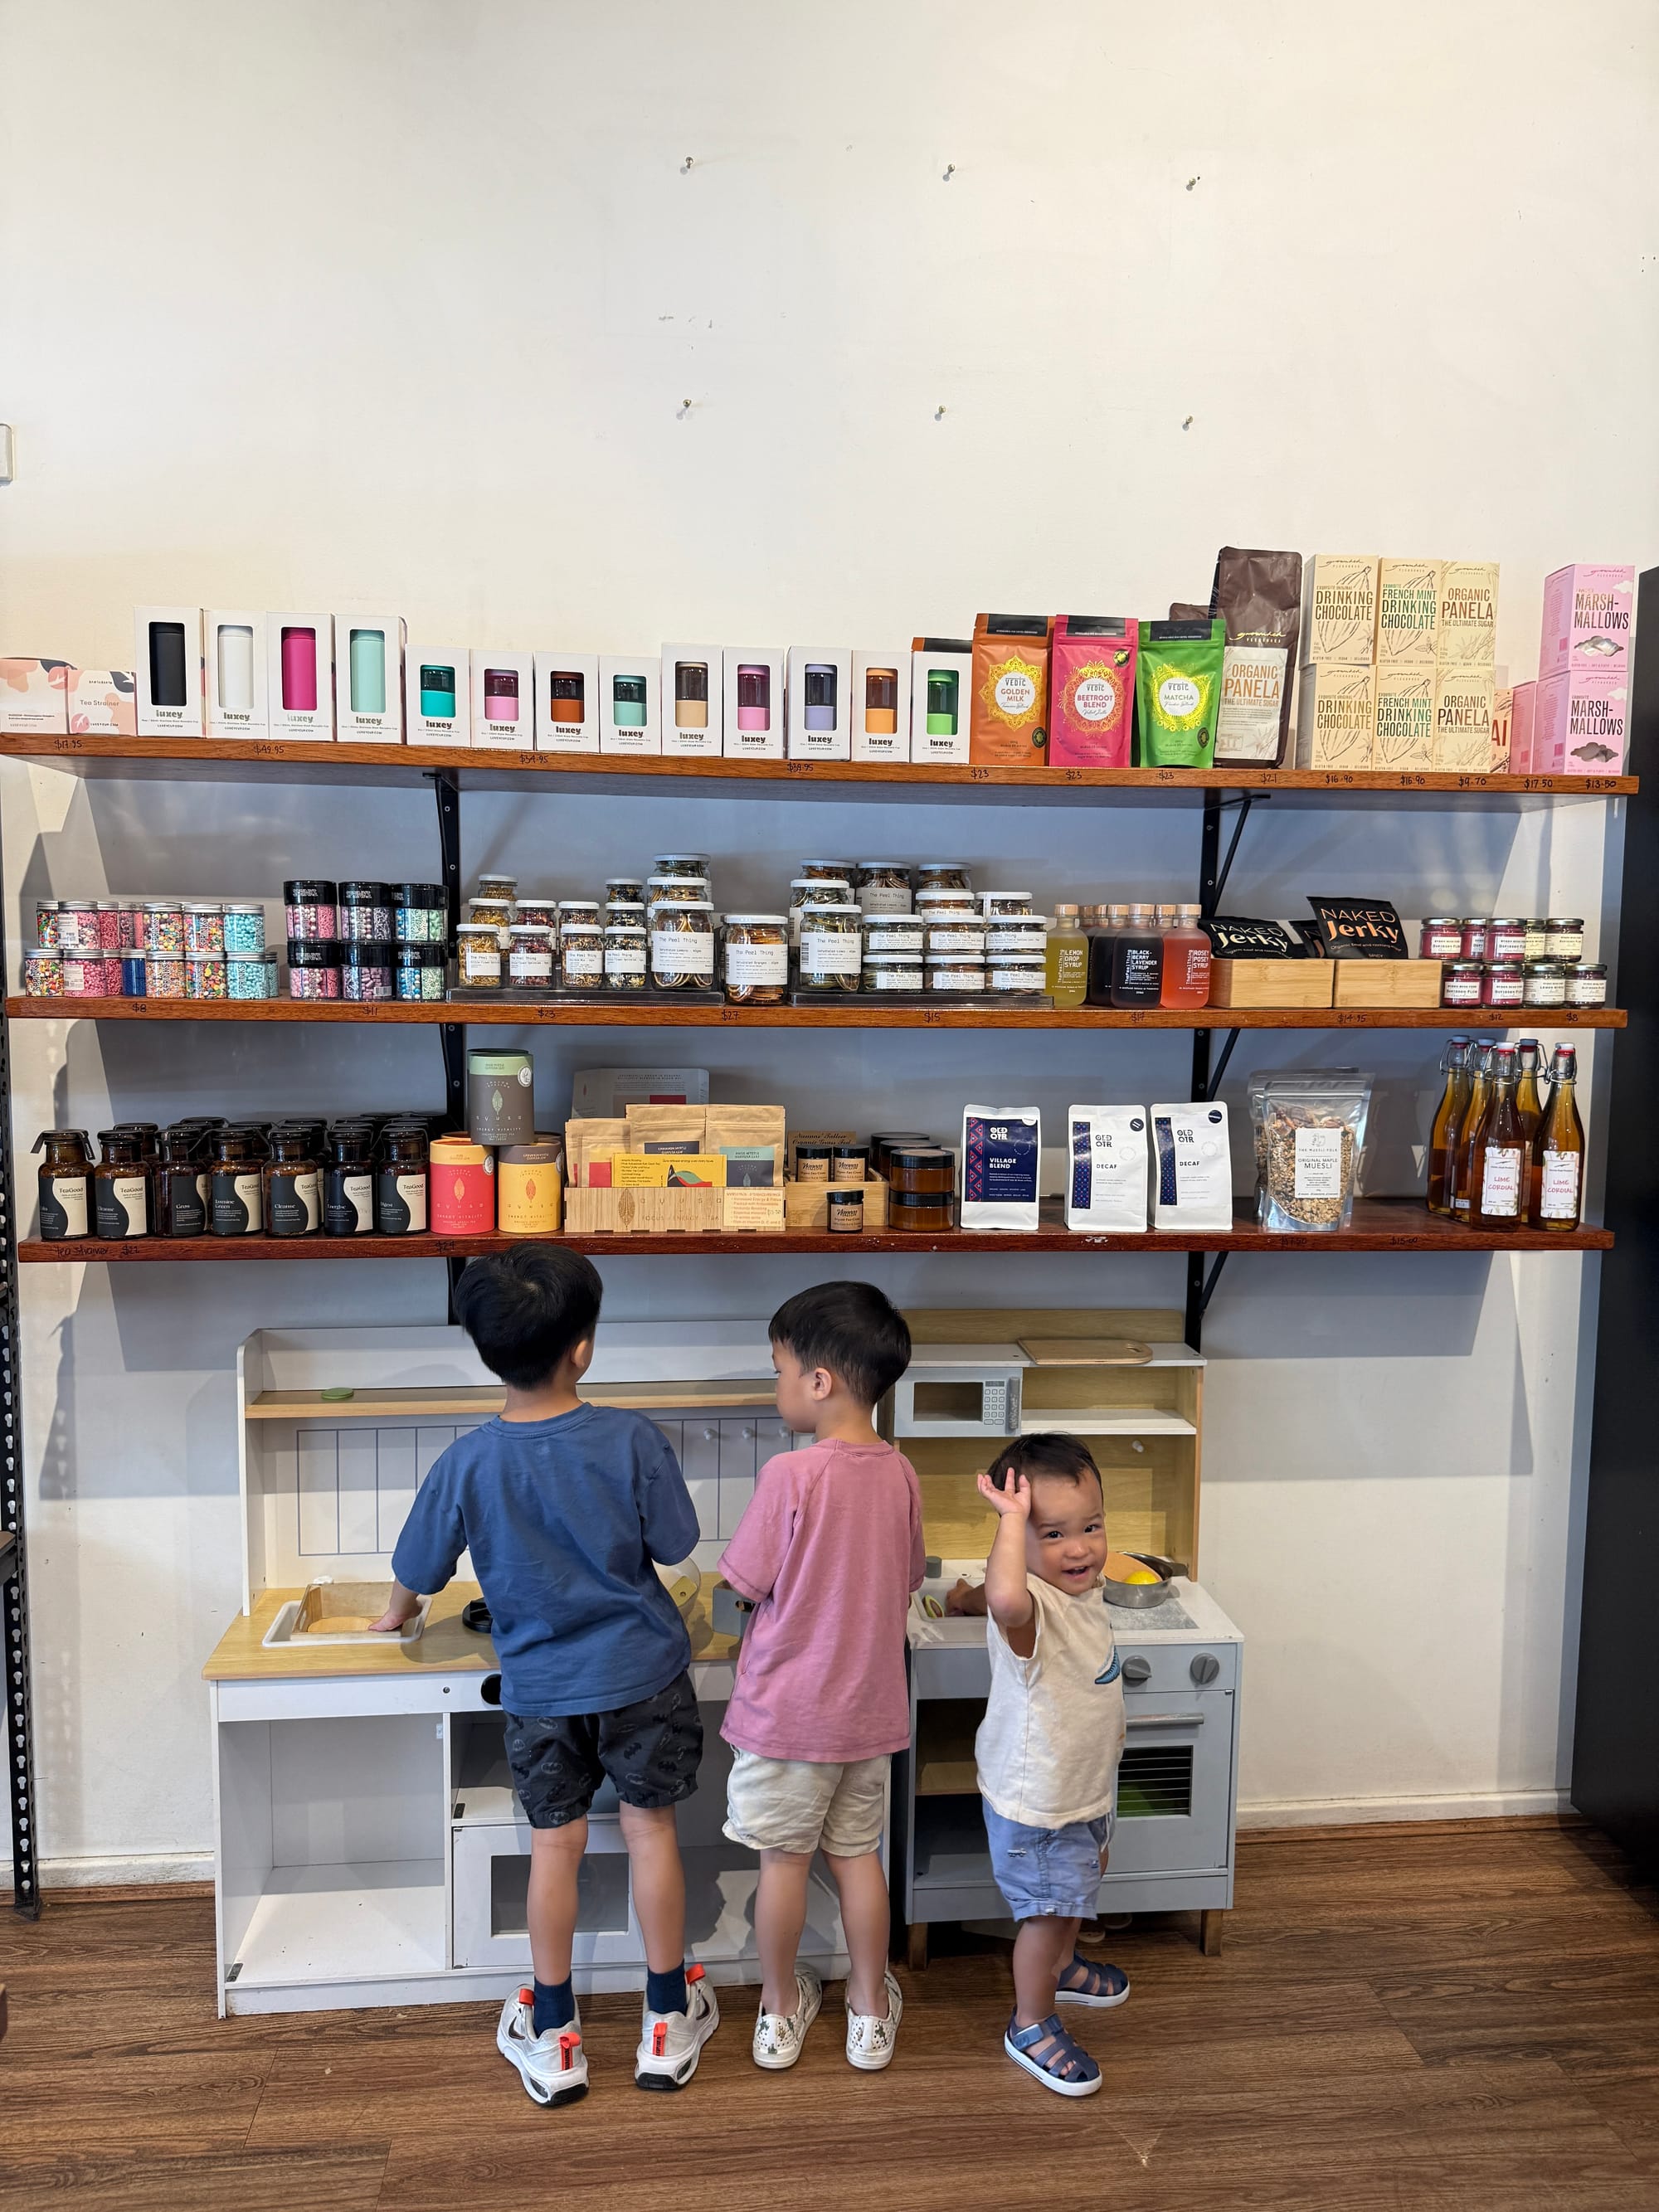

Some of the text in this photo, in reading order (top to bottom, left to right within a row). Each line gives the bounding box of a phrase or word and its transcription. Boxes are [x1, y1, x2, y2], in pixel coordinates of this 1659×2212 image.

[1316, 591, 1374, 605] DRINKING
[1382, 589, 1438, 600] FRENCH MINT
[1447, 587, 1491, 601] ORGANIC
[1382, 600, 1437, 614] DRINKING
[1575, 593, 1619, 610] MARSH-
[1315, 605, 1373, 620] CHOCOLATE
[1441, 601, 1493, 620] PANELA
[1381, 614, 1436, 630] CHOCOLATE
[1574, 611, 1629, 630] MALLOWS
[1232, 664, 1278, 679] ORGANIC
[1224, 678, 1280, 699] PANELA
[1317, 699, 1372, 714] DRINKING
[1378, 698, 1433, 708] FRENCH MINT
[1443, 695, 1486, 708] ORGANIC
[156, 709, 183, 719] luxey
[1377, 708, 1432, 722] DRINKING
[1571, 700, 1613, 717] MARSH-
[223, 712, 251, 722] luxey
[355, 716, 382, 725] luxey
[1316, 713, 1371, 730] CHOCOLATE
[1438, 708, 1490, 727] PANELA
[426, 720, 452, 730] luxey
[489, 723, 516, 733] luxey
[556, 726, 581, 735] luxey
[1377, 722, 1431, 737] CHOCOLATE
[1569, 717, 1623, 736] MALLOWS
[618, 729, 644, 737] luxey
[679, 732, 704, 741] luxey
[741, 735, 766, 744] luxey
[808, 735, 832, 744] luxey
[868, 738, 893, 746] luxey
[930, 739, 953, 747] luxey
[971, 767, 990, 780] $23
[1065, 770, 1082, 780] $23
[1261, 773, 1277, 783] $21
[1321, 908, 1396, 923] NAKED
[1210, 923, 1284, 937] NAKED
[1326, 920, 1399, 943] Jerky
[1217, 931, 1288, 953] Jerky
[237, 965, 246, 993] SPRINKS
[133, 1002, 147, 1013] $8
[722, 1009, 740, 1021] $27
[924, 1012, 944, 1023] $15
[1489, 1013, 1504, 1022] $12
[1566, 1013, 1579, 1022] $8
